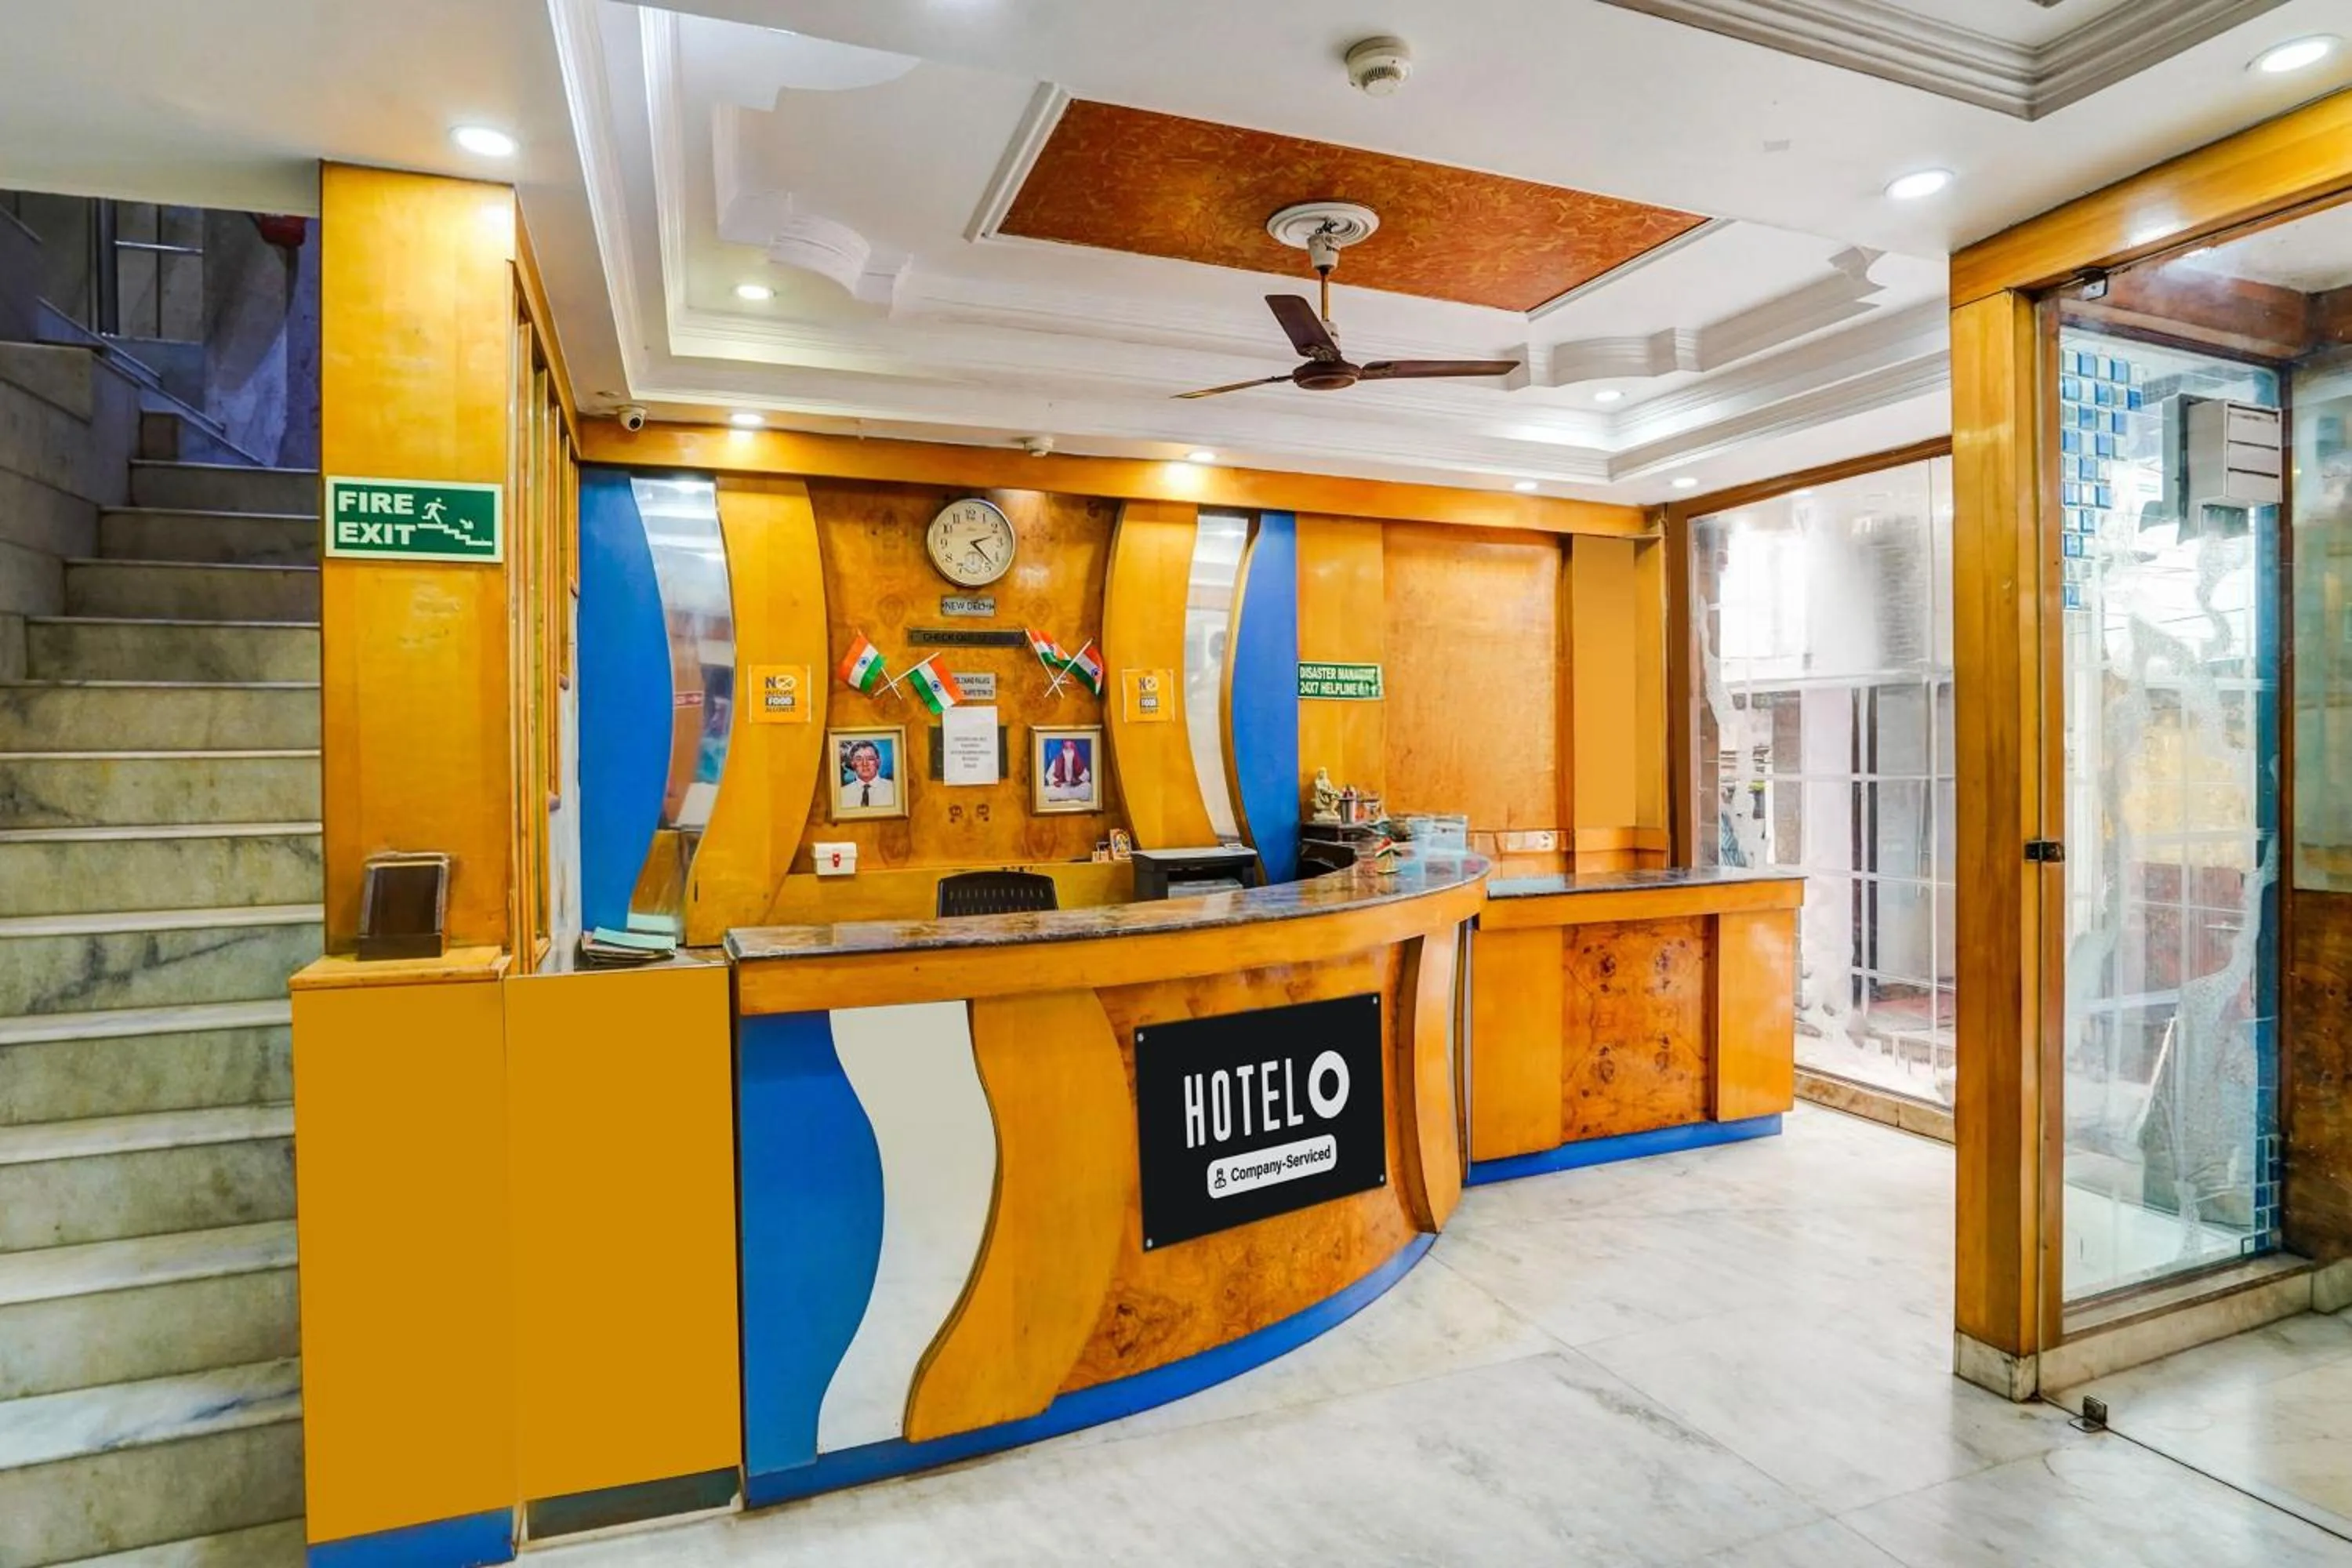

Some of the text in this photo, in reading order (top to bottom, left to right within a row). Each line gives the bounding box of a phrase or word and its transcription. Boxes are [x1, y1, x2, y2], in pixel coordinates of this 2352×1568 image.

[338, 491, 414, 514] FIRE
[965, 507, 976, 520] 12
[338, 521, 416, 545] EXIT
[991, 523, 998, 534] 2
[944, 601, 993, 612] NEW DELHI
[1299, 666, 1337, 680] DISASTER
[1299, 681, 1319, 694] 24X7
[1320, 681, 1357, 695] HELPLINE
[1185, 1058, 1304, 1149] HOTEL
[1231, 1145, 1331, 1181] Company-Serviced
